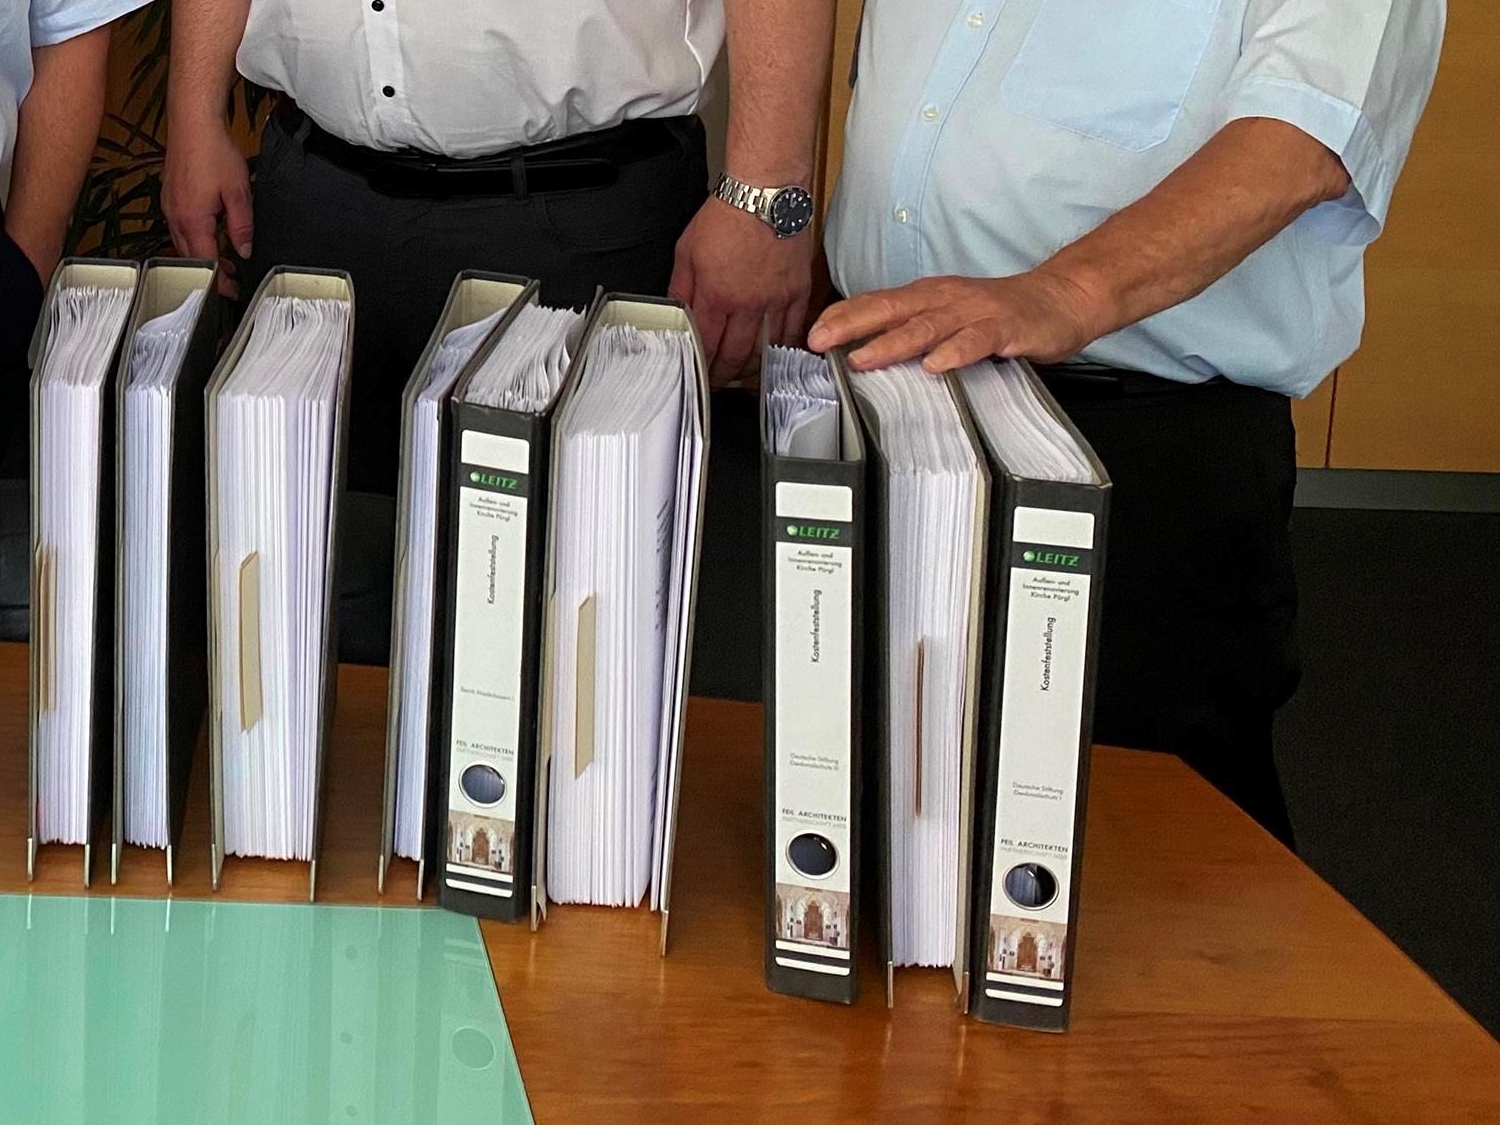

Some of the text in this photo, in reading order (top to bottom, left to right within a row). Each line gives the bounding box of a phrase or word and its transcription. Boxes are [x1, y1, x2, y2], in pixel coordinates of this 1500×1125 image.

[481, 473, 518, 489] LEITZ
[799, 525, 841, 540] LEITZ
[1035, 552, 1080, 567] LEITZ
[486, 534, 499, 604] Kostenfeststellung
[810, 589, 823, 664] Kostenfeststellung
[1040, 617, 1057, 692] Kostenfeststellung
[471, 742, 515, 755] ARCHITEKTEN
[798, 810, 847, 822] ARCHITEKTEN
[1018, 841, 1069, 853] ARCHITEKTEN
